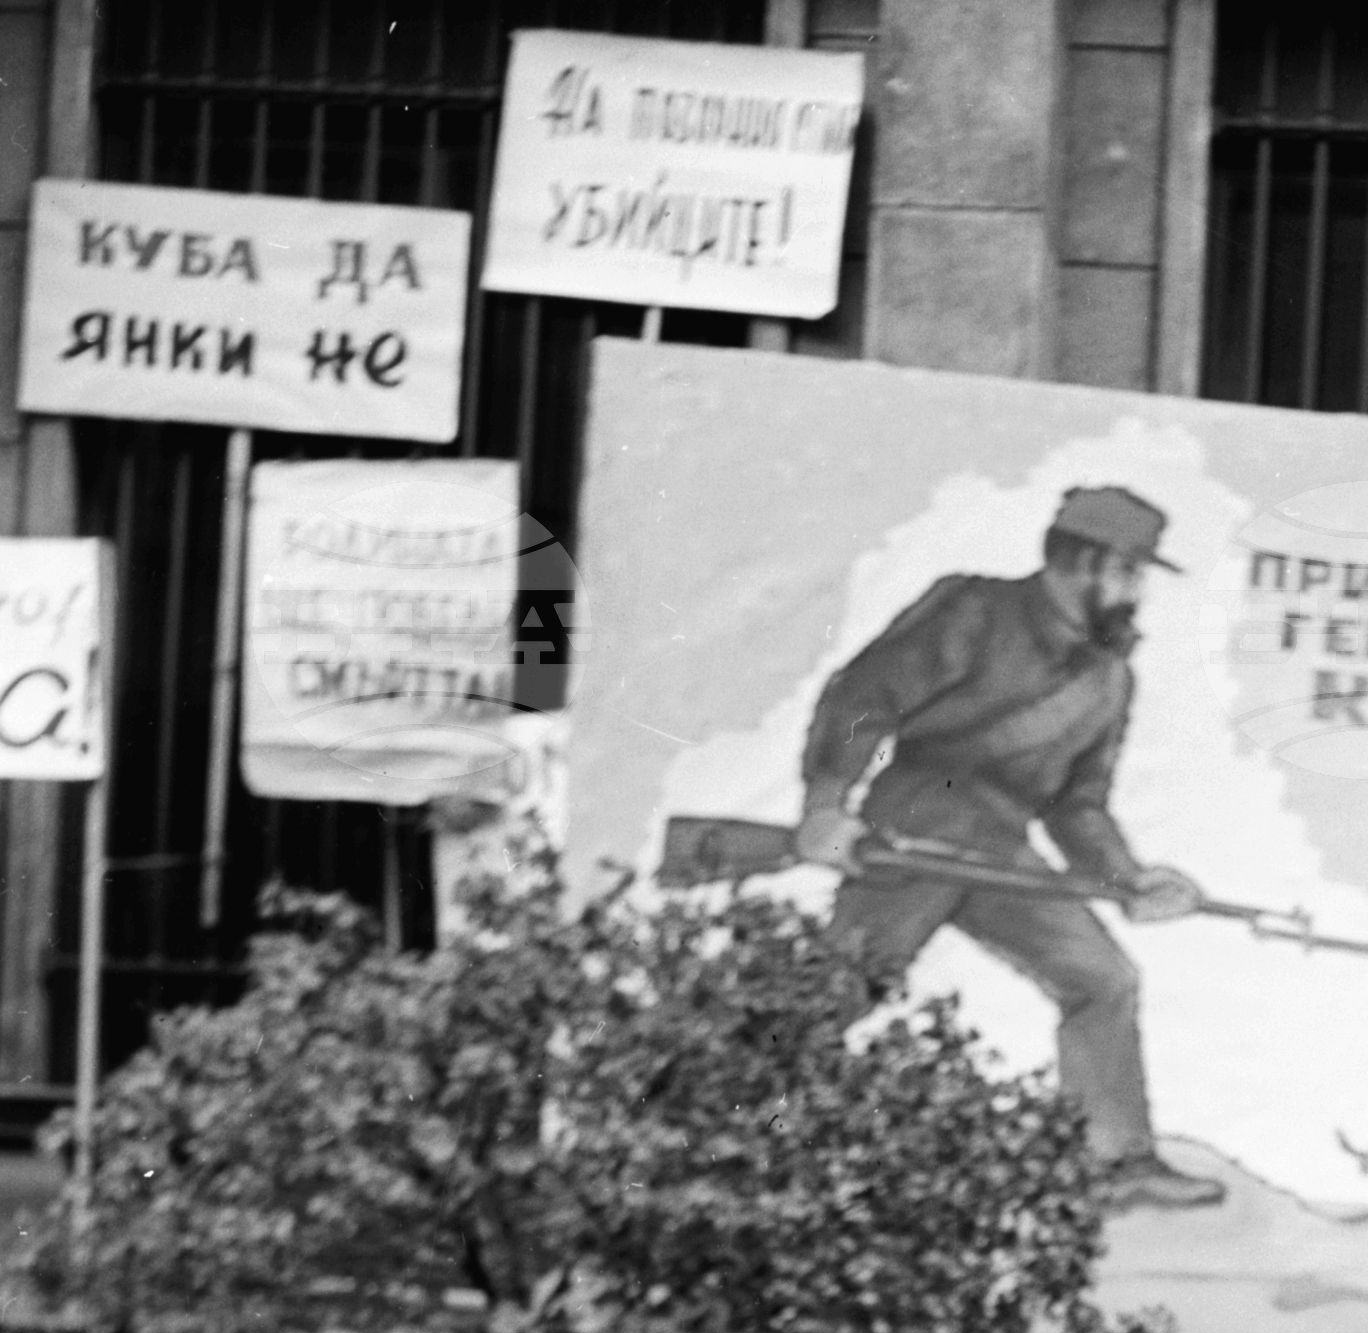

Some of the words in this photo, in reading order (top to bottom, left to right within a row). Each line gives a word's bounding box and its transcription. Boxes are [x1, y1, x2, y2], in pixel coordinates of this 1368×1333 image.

[76, 218, 263, 286] КУБА
[314, 236, 425, 305] ДА
[59, 309, 257, 378] ЯНКИ
